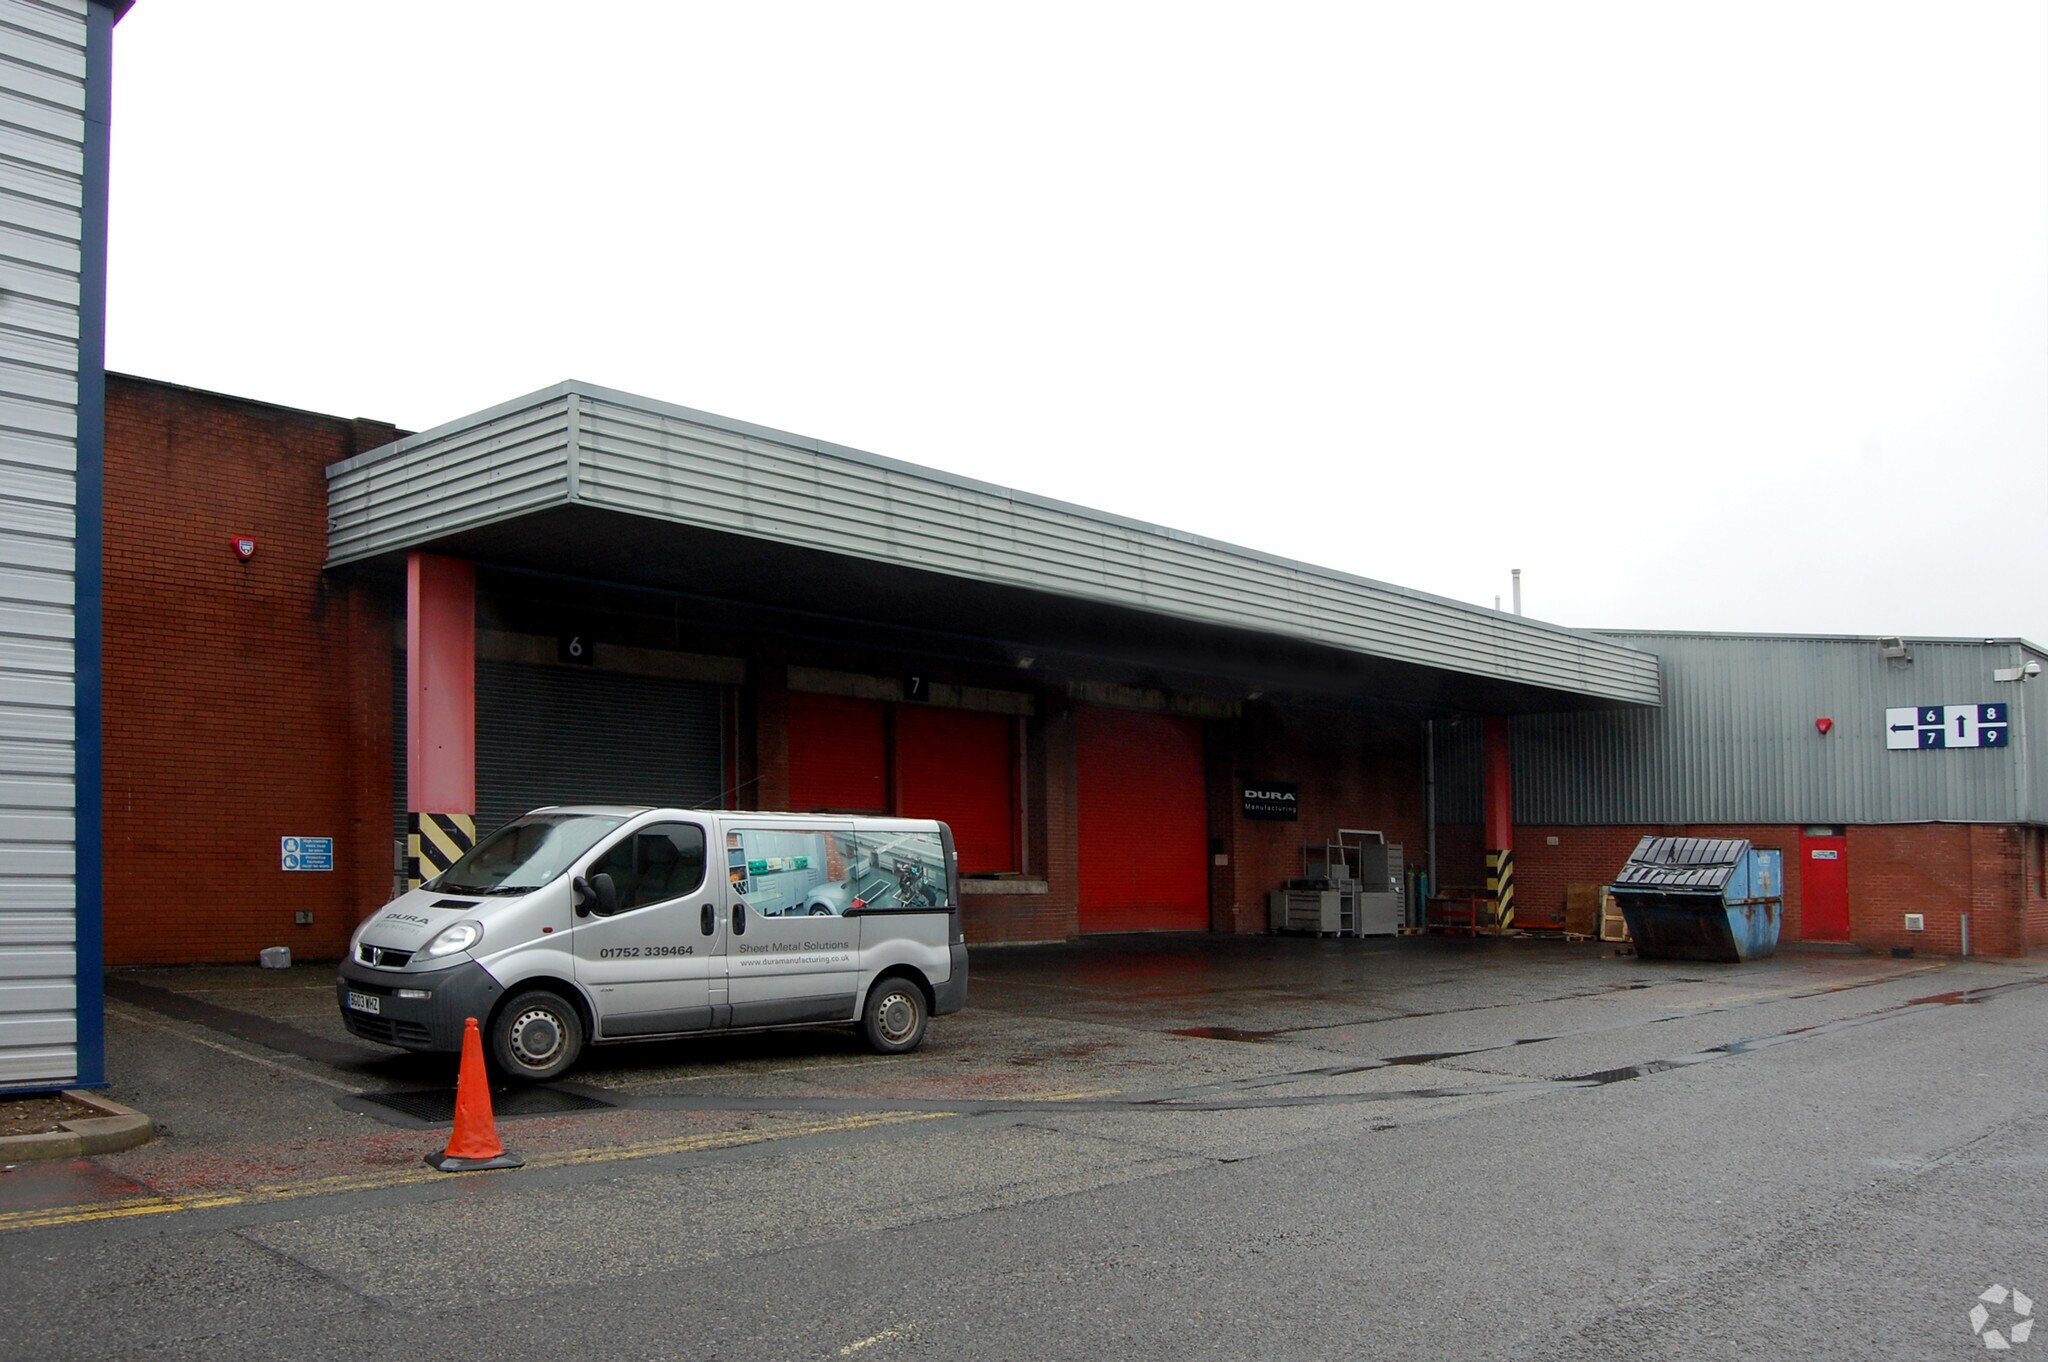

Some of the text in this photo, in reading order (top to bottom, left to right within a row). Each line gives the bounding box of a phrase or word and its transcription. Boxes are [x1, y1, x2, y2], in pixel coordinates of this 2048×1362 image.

[570, 636, 582, 657] 6
[912, 676, 920, 694] 7
[1925, 710, 1936, 722] 6
[1986, 707, 1997, 720] 8
[1926, 732, 1936, 744] 7
[1987, 730, 1998, 742] 9
[1245, 790, 1296, 801] DURA
[1245, 803, 1297, 814] Manufacturing
[386, 913, 429, 925] DURA
[600, 945, 694, 959] 01752 339464
[739, 940, 849, 954] Sheet Metal Solutions
[740, 954, 850, 967] www.duramanufacturing.co.uk
